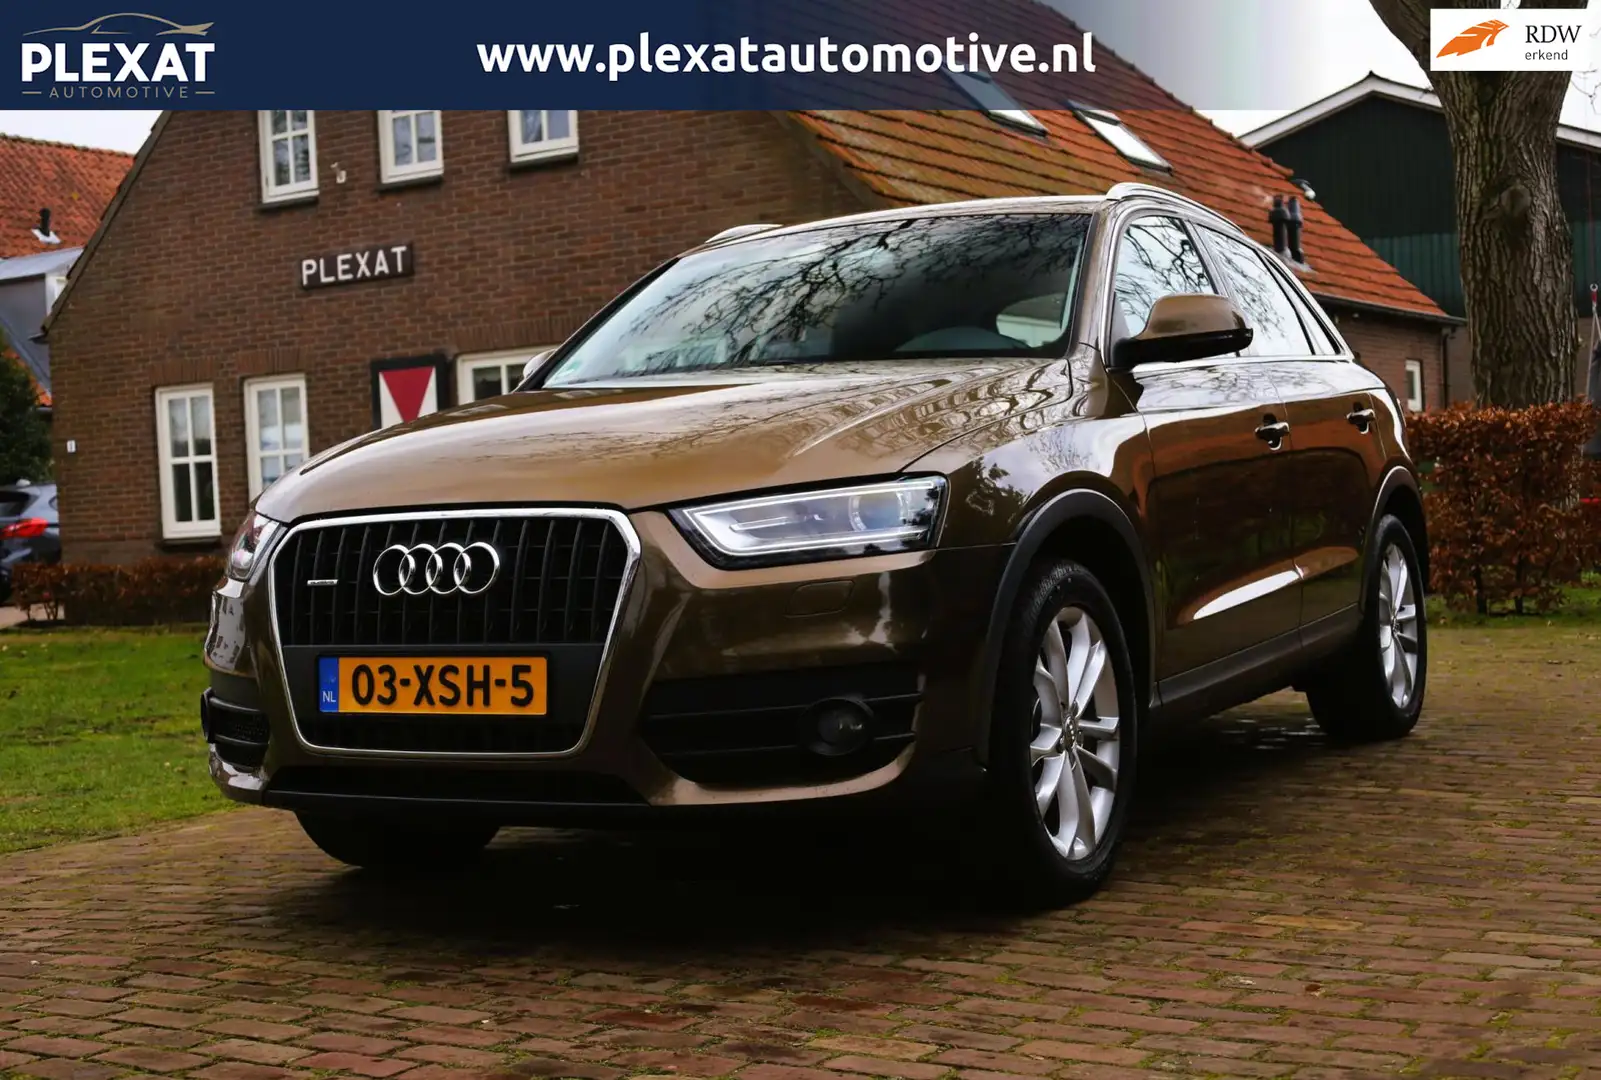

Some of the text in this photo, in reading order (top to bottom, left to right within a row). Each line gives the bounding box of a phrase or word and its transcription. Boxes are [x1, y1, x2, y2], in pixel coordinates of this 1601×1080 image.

[302, 246, 408, 286] PLEXAT
[322, 690, 337, 703] NL
[351, 664, 534, 707] 03-XSH-5
